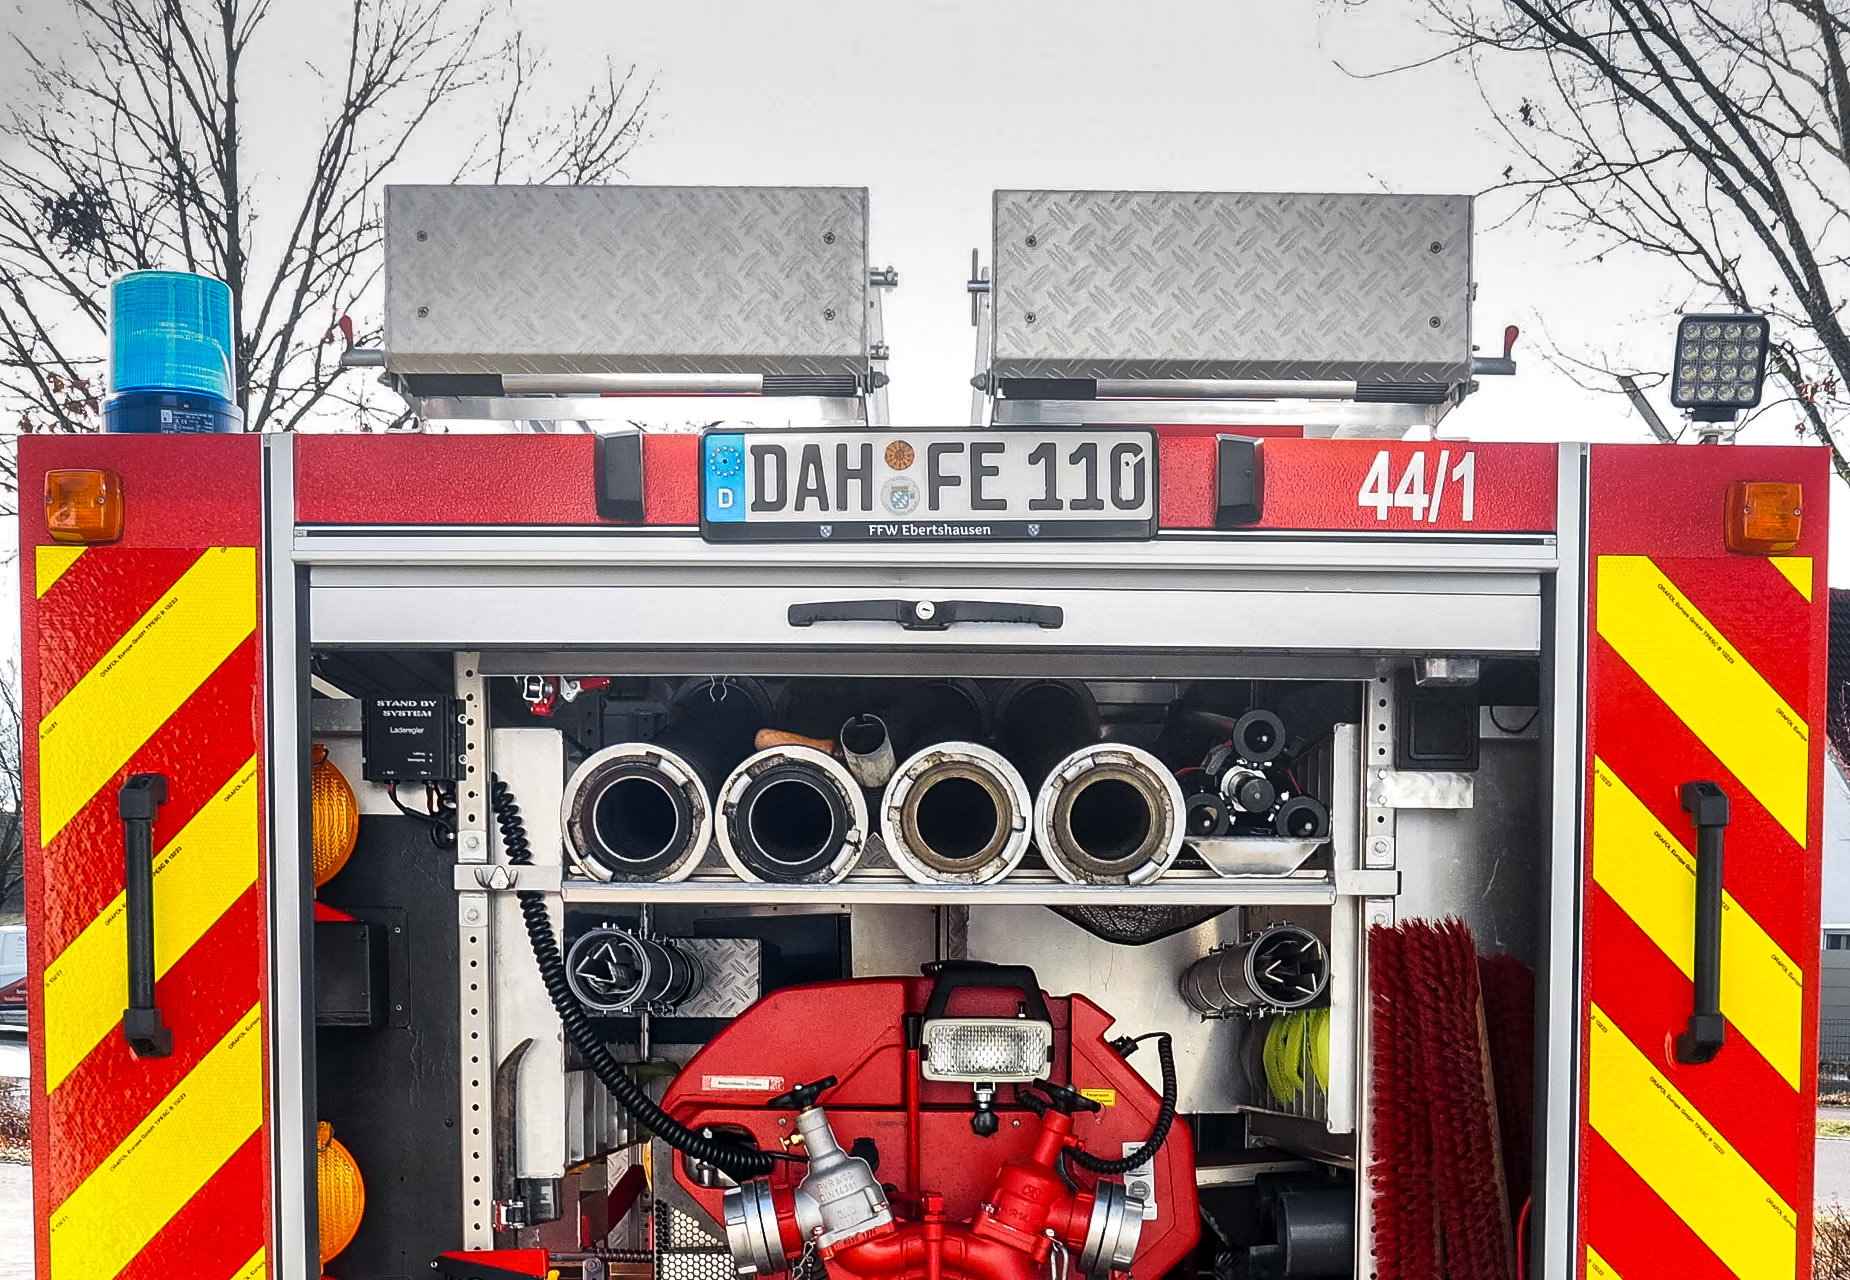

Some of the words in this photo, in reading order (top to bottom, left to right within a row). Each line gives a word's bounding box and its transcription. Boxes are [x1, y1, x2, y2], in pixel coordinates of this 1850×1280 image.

[750, 443, 875, 512] DAH
[928, 443, 1006, 511] FE
[1027, 443, 1146, 511] 110
[1358, 449, 1475, 522] 44/1
[717, 487, 734, 508] D
[869, 524, 898, 536] FFW
[901, 523, 992, 537] Ebertshausen
[390, 726, 425, 735] Laderegler
